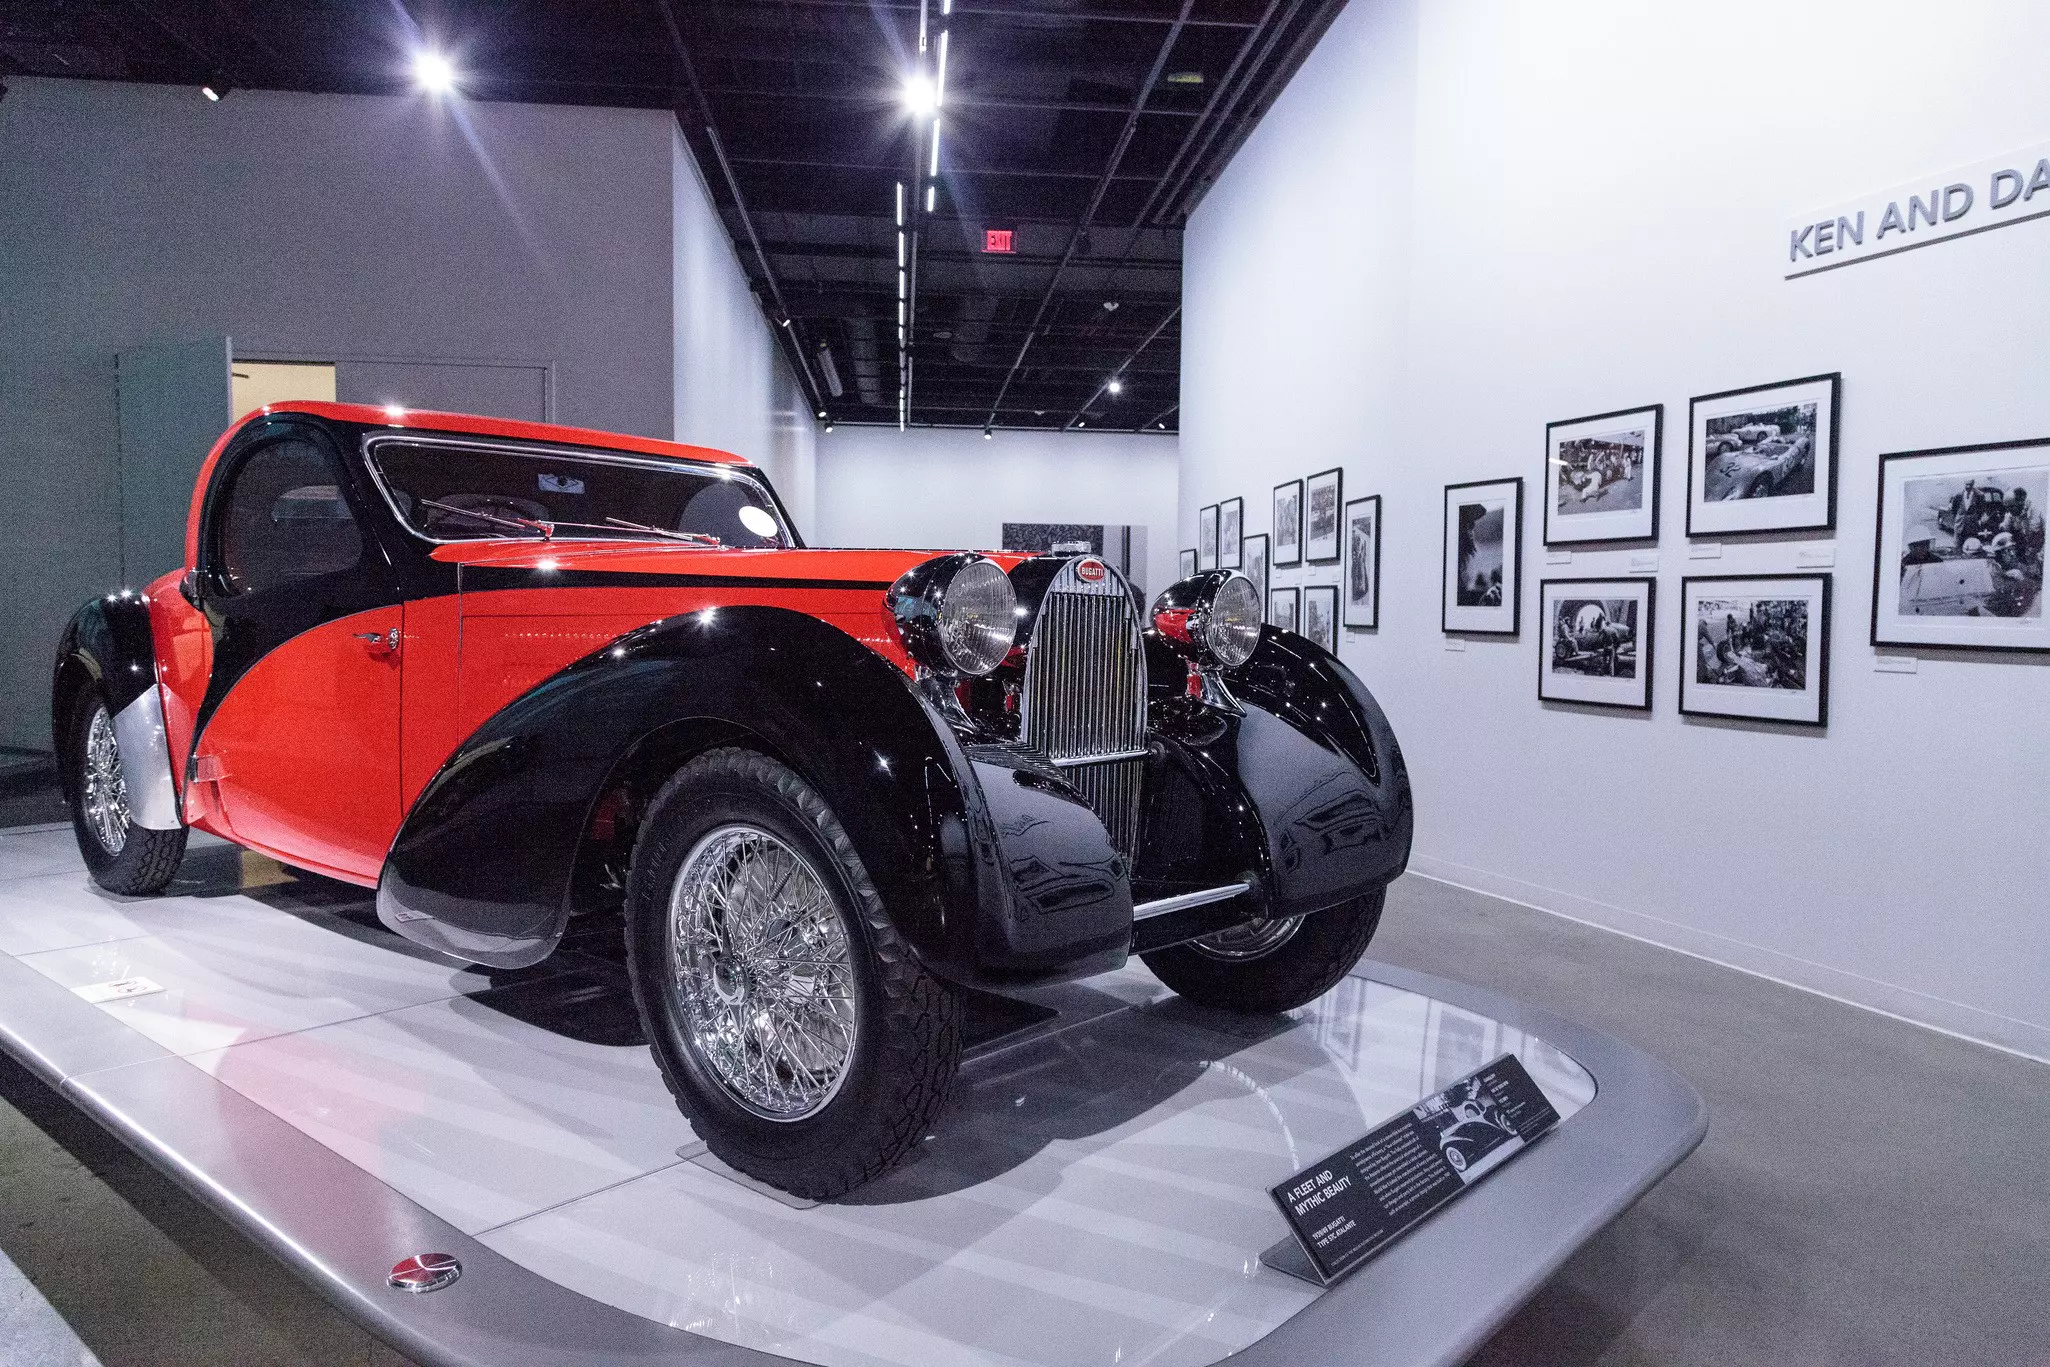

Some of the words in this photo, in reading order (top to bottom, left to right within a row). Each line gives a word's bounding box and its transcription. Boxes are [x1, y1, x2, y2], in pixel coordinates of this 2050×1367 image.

[1789, 210, 1865, 262] KEN
[1876, 182, 1974, 240] AND
[1989, 158, 2050, 210] DA
[987, 230, 1013, 251] EXIT
[1081, 567, 1104, 576] BUGATTI
[1287, 1192, 1296, 1203] A
[1294, 1179, 1317, 1199] FLEET
[1315, 1170, 1334, 1186] AND
[1295, 1192, 1326, 1216] MYTHIC
[1323, 1176, 1352, 1199] BEAUTY
[1318, 1238, 1329, 1249] TYPE
[1328, 1233, 1337, 1242] 57C
[1335, 1220, 1356, 1237] ATALANTE
[1327, 1216, 1346, 1231] BUGATTI
